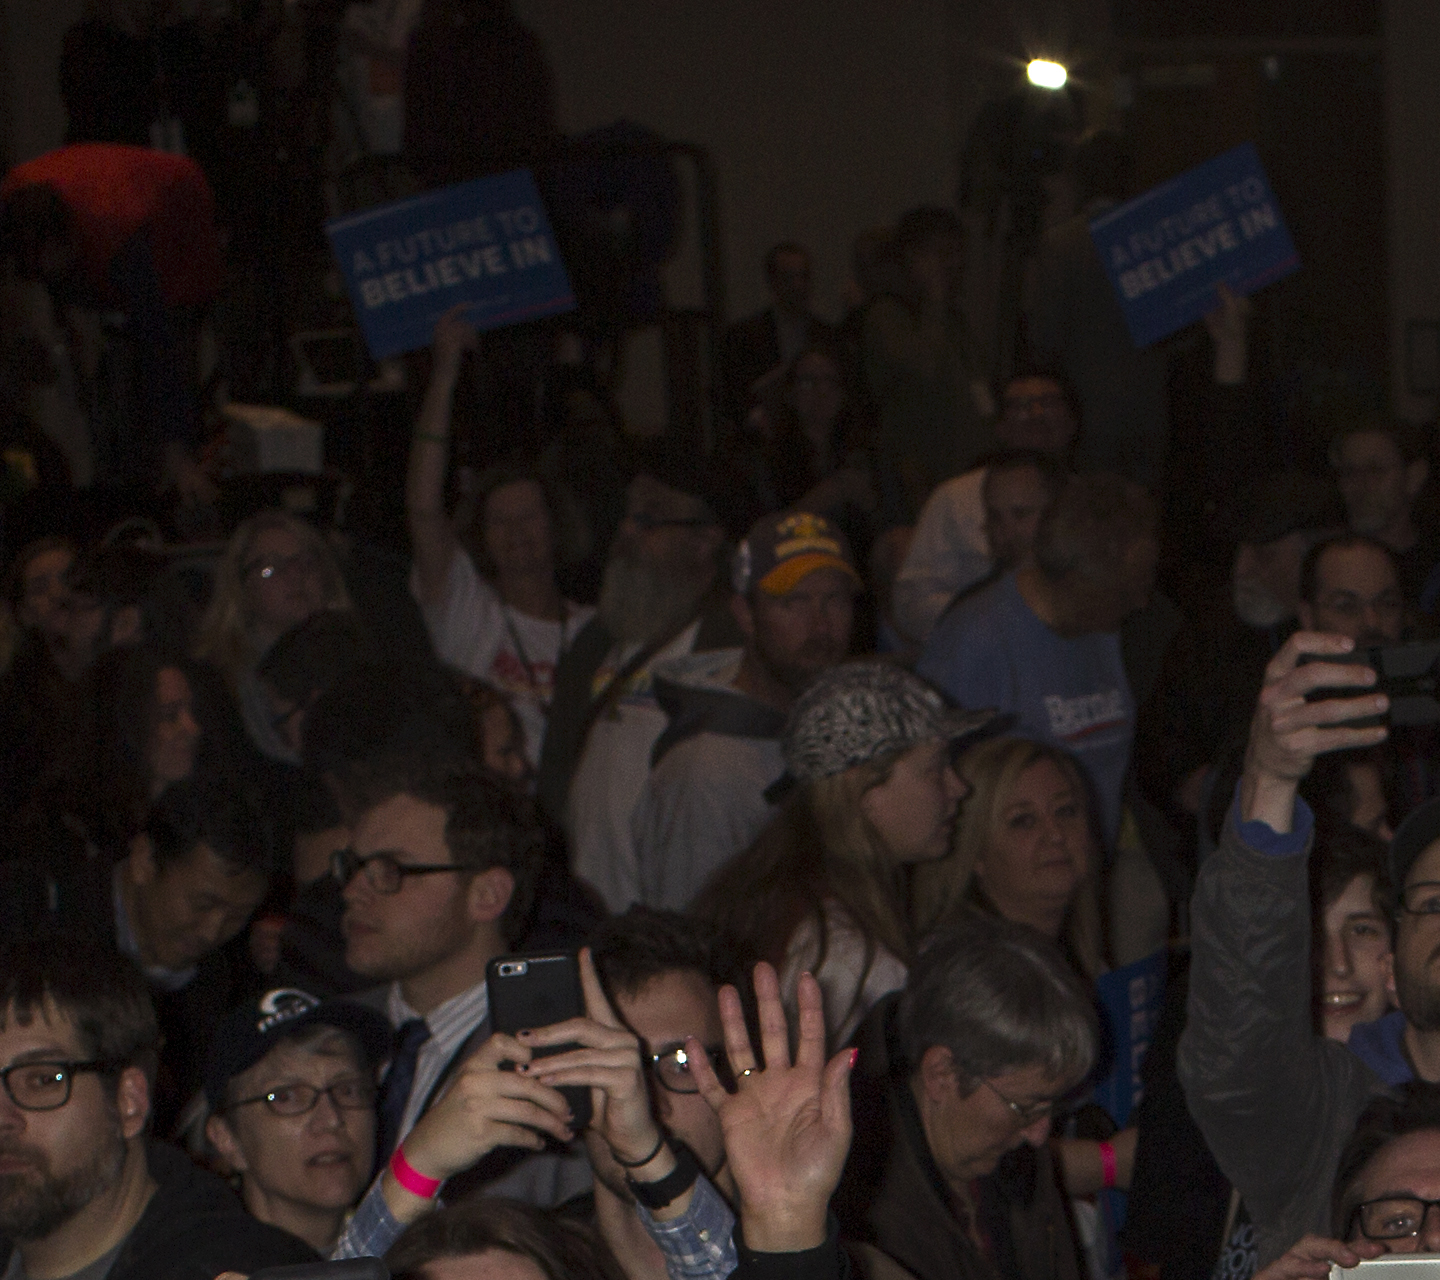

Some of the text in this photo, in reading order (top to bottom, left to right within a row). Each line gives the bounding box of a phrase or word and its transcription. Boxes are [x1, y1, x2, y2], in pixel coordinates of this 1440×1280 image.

[353, 205, 539, 276] A FUTURE TO
[1118, 202, 1278, 300] BELIEVE IN
[1127, 194, 1224, 257] FUTURE
[1225, 175, 1265, 209] TO
[360, 233, 553, 309] BELIEVE IN
